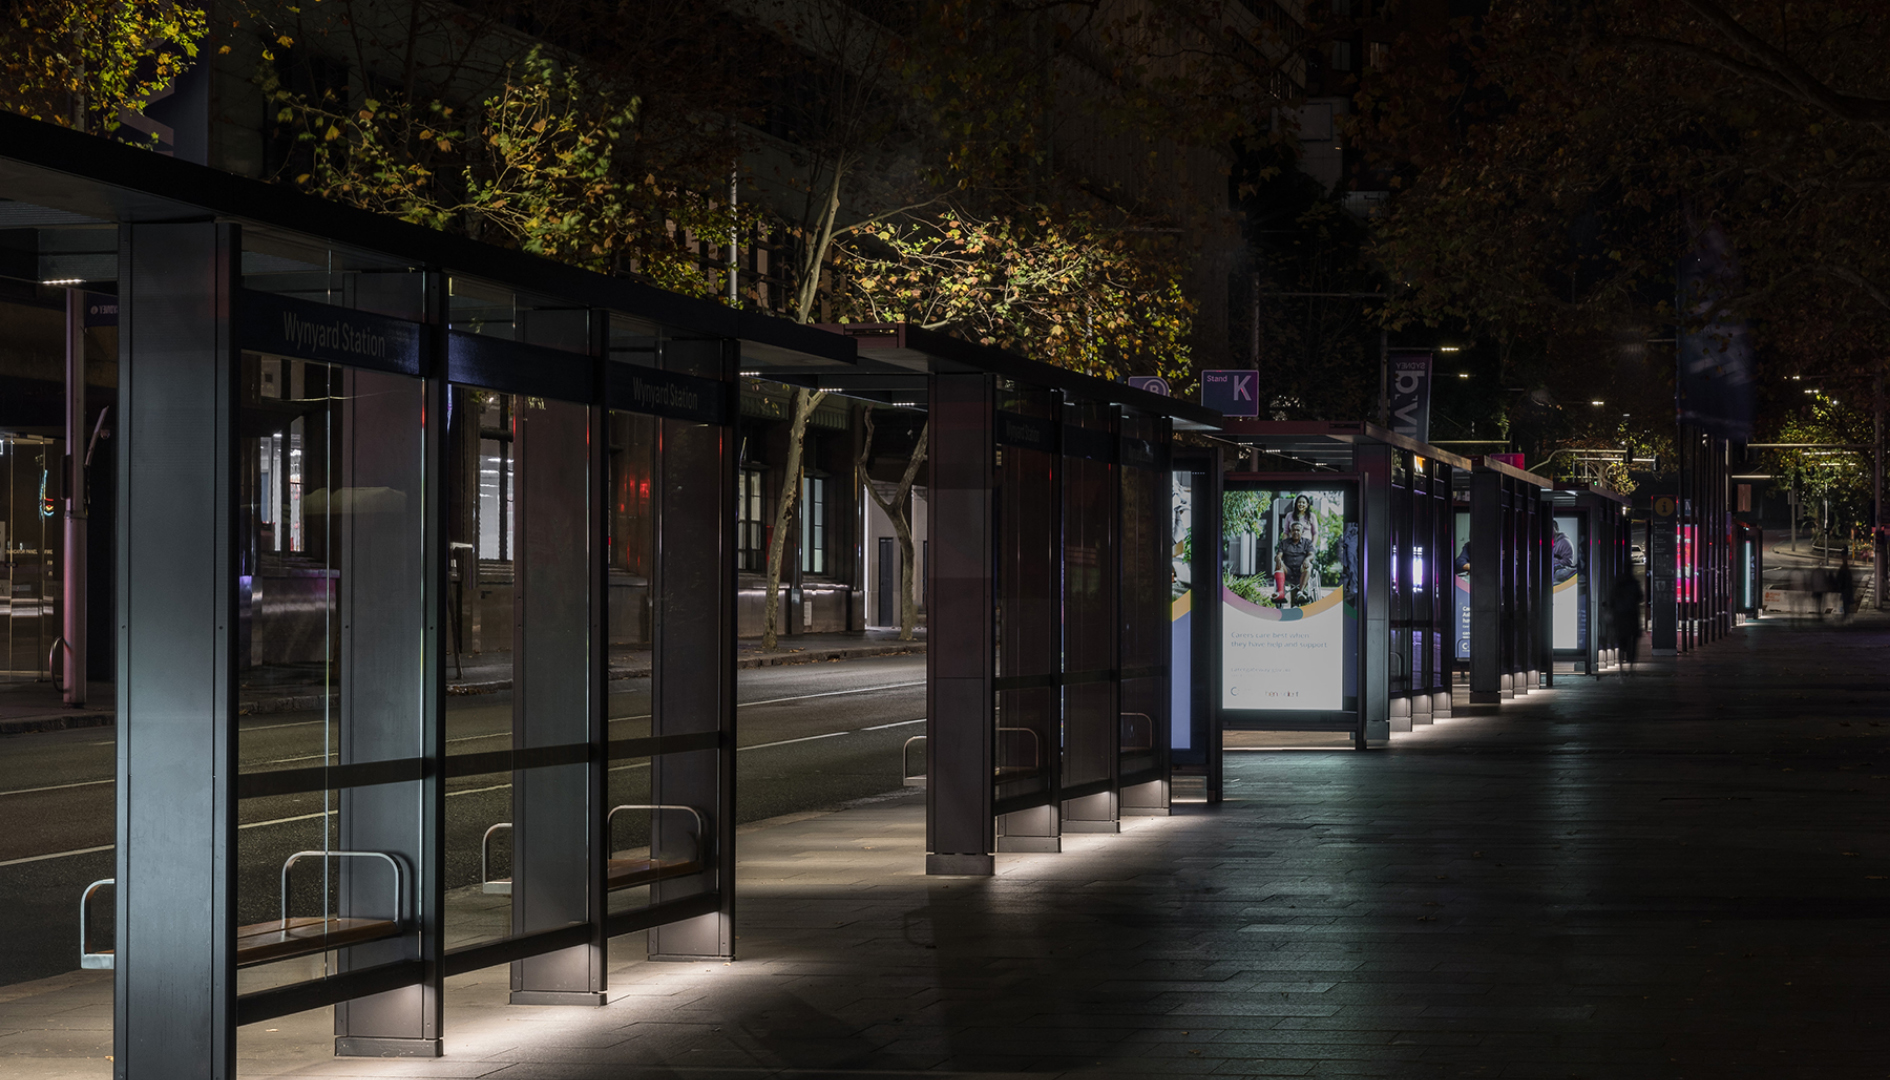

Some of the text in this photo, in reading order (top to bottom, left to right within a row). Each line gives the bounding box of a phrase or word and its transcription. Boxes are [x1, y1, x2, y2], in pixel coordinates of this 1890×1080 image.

[283, 311, 386, 358] Wynyard Station
[633, 376, 698, 410] Wynyard Station
[1233, 375, 1252, 400] K
[1231, 631, 1254, 639] Carers
[1231, 641, 1247, 649] they
[1267, 641, 1283, 649] help
